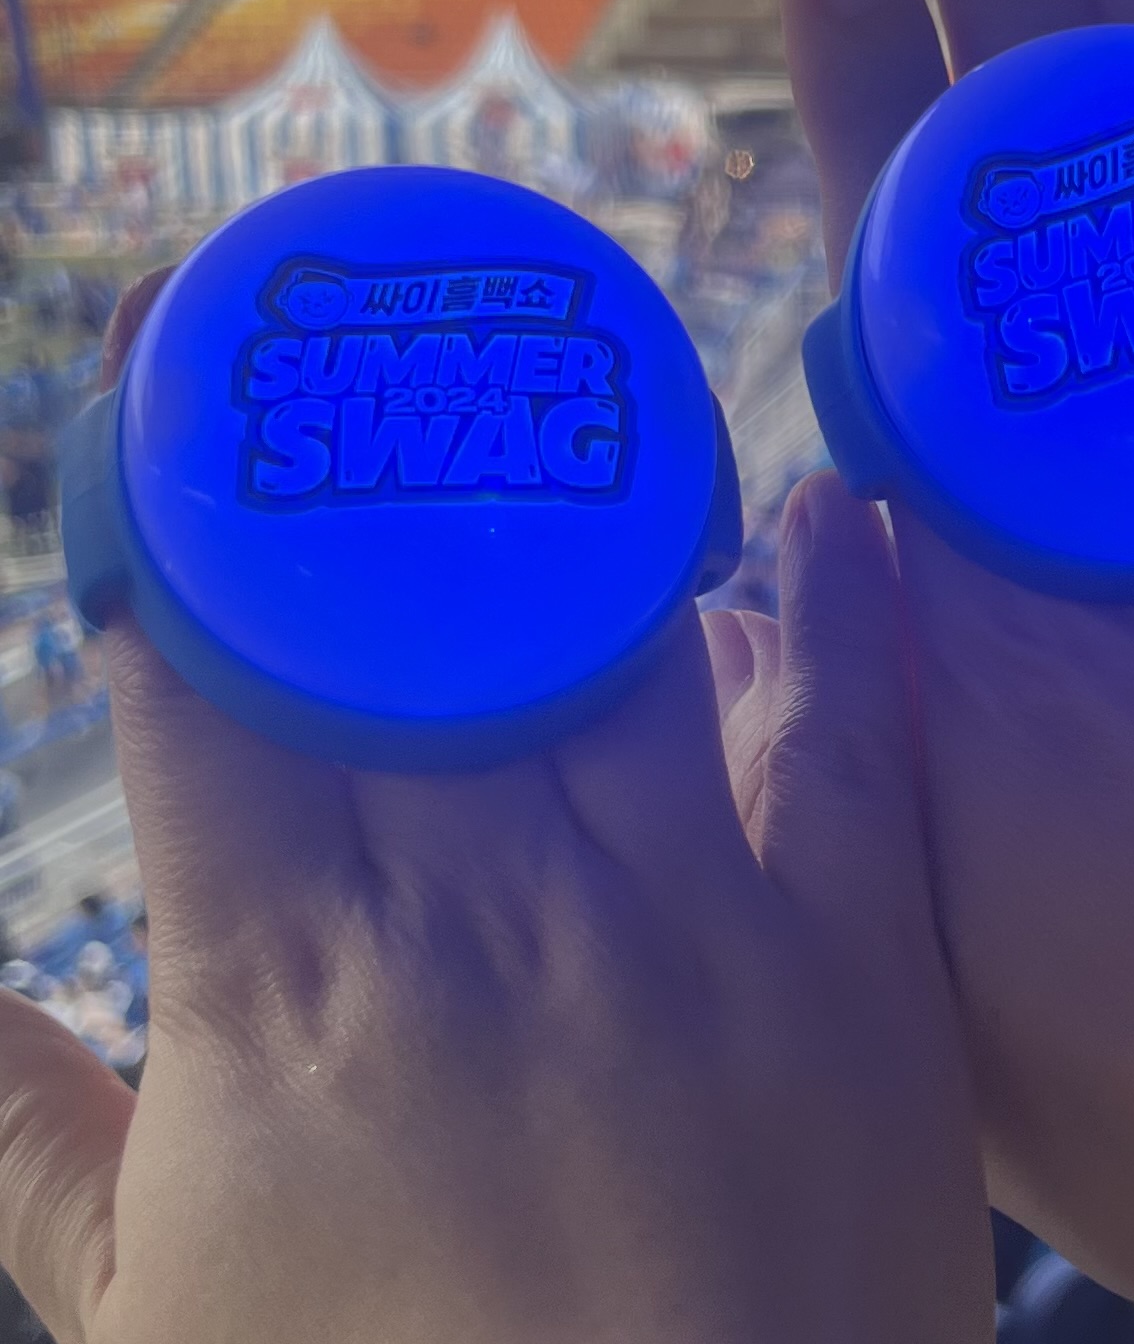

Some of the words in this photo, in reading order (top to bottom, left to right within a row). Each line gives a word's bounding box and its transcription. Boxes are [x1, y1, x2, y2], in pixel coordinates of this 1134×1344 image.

[360, 275, 556, 316] 싸이흠뻑쇼
[245, 333, 615, 400] SUMMER
[383, 386, 509, 416] 2024
[255, 396, 622, 497] SWAG
